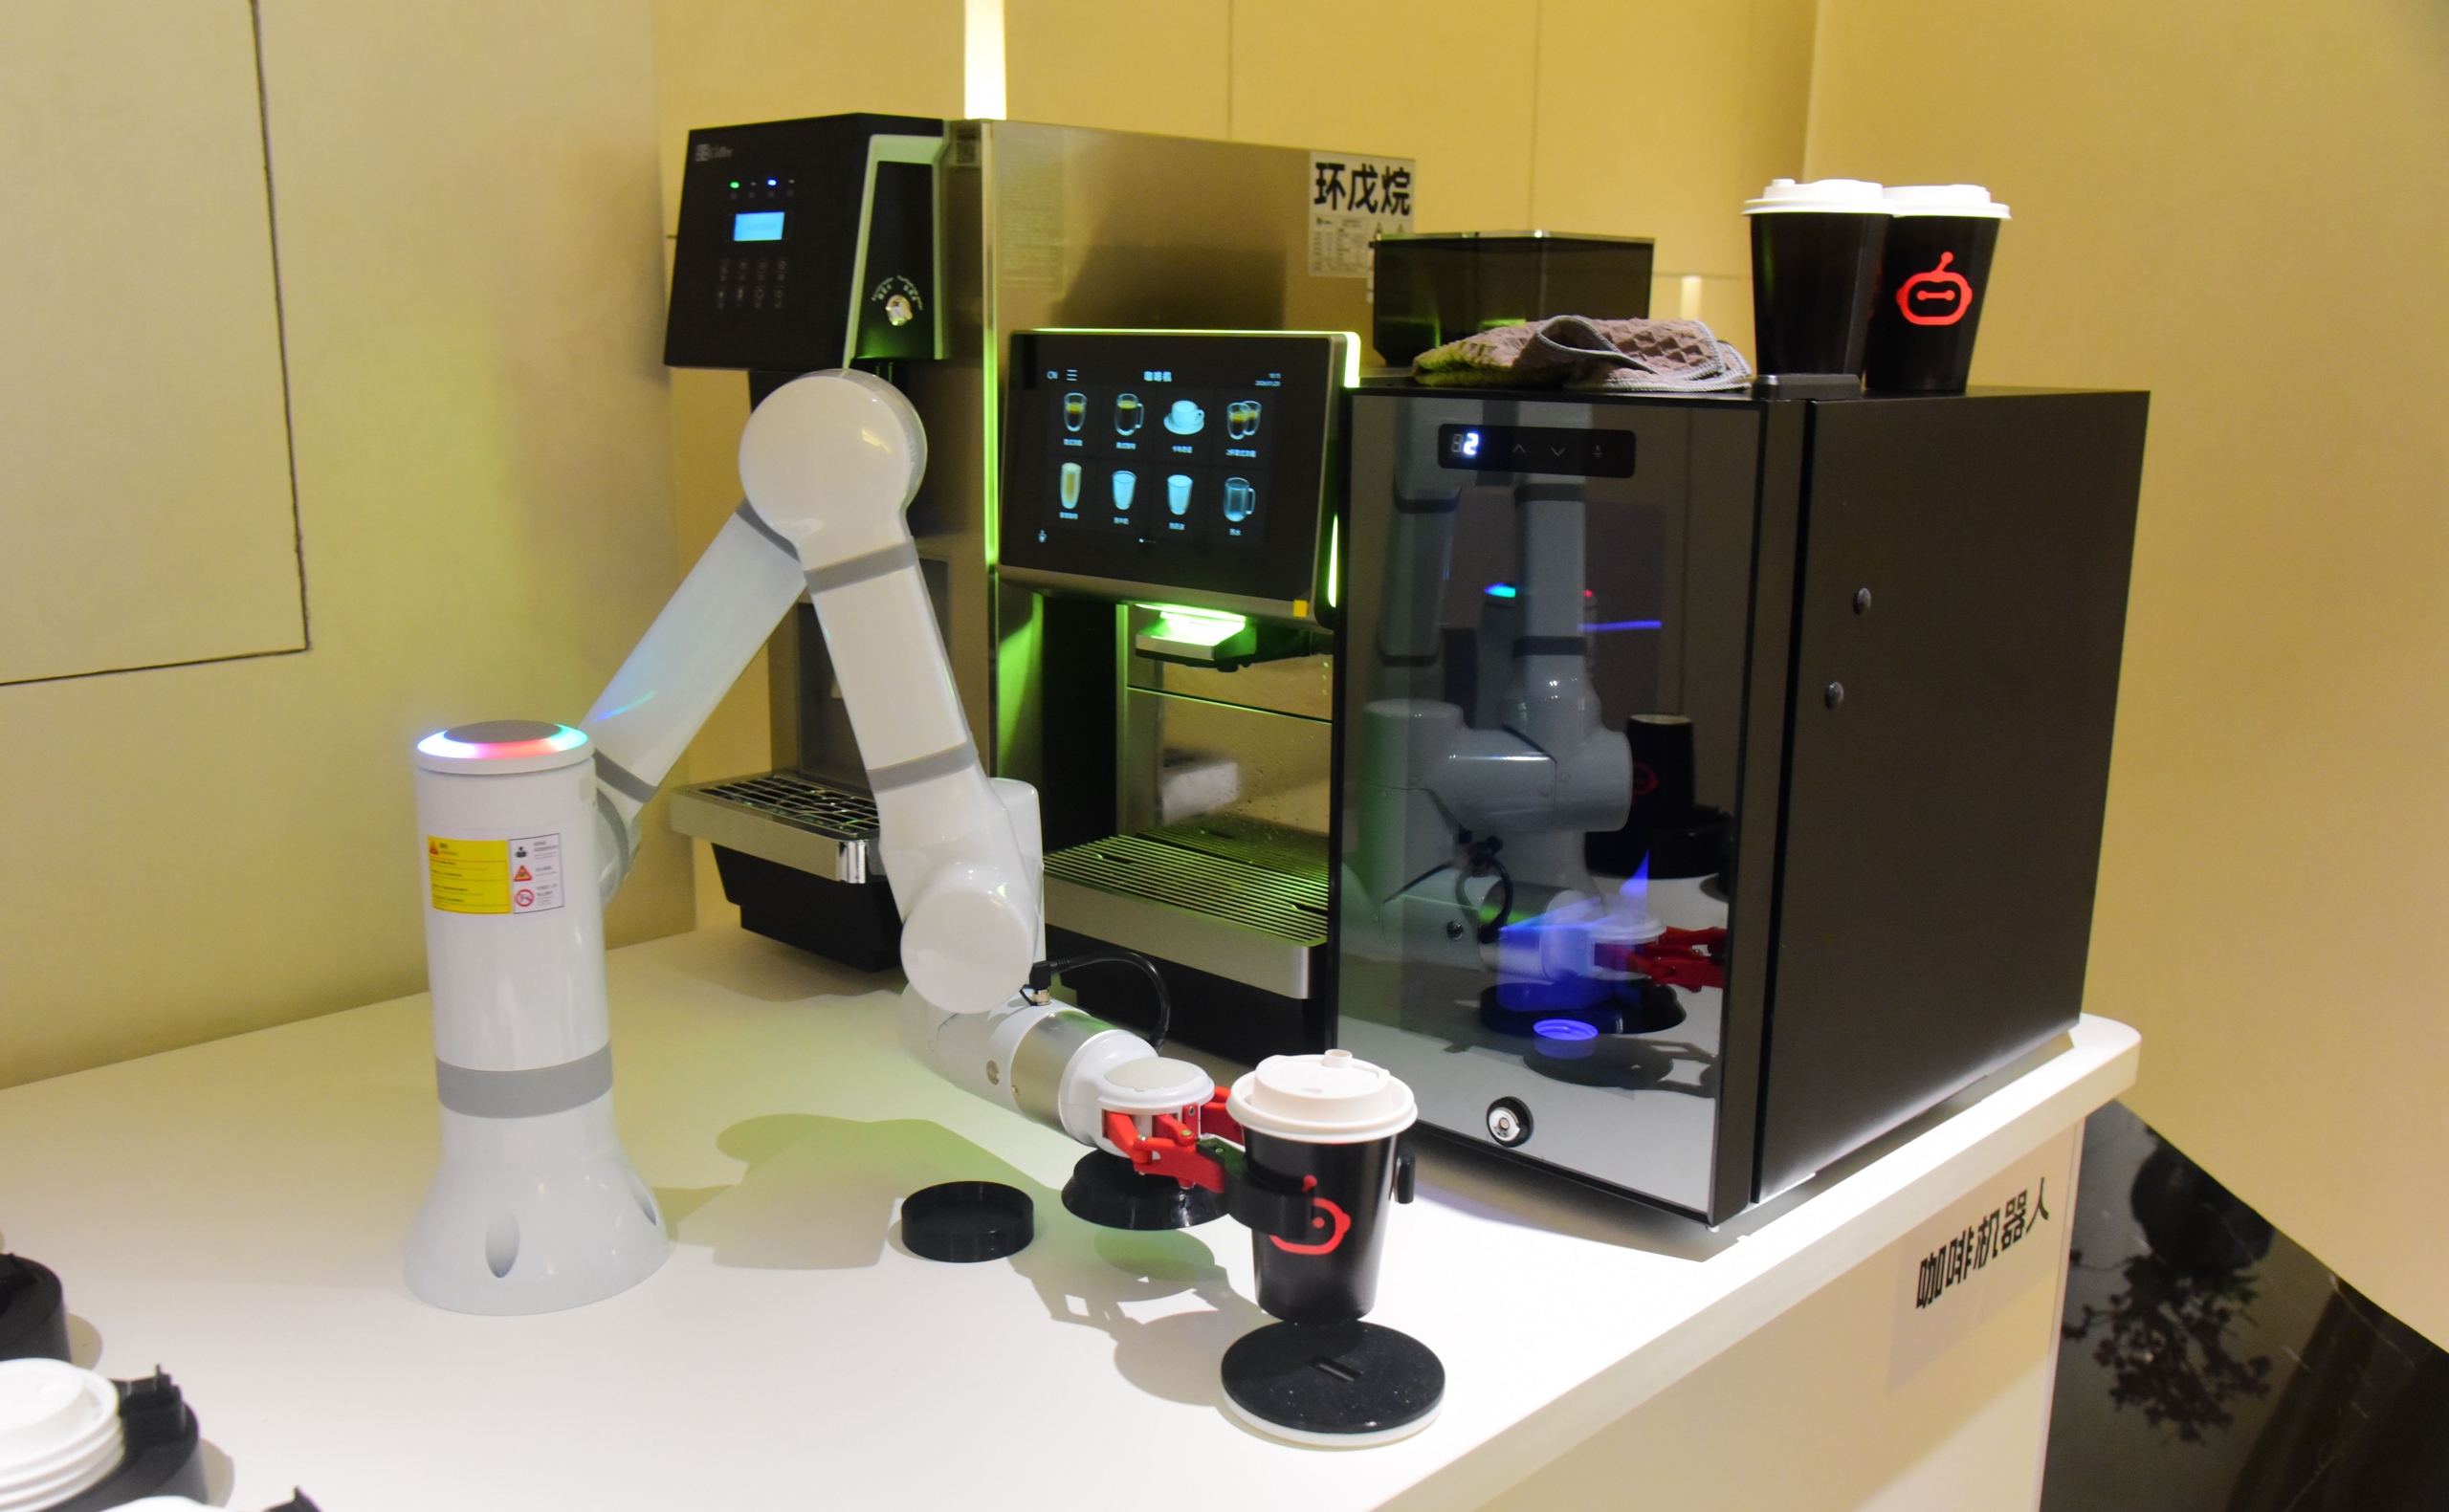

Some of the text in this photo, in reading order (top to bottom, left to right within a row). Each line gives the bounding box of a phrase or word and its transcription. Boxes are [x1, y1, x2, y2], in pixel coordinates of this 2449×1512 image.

[1313, 162, 1411, 216] 环戊烷
[1915, 1176, 2049, 1309] 咖啡机器人
